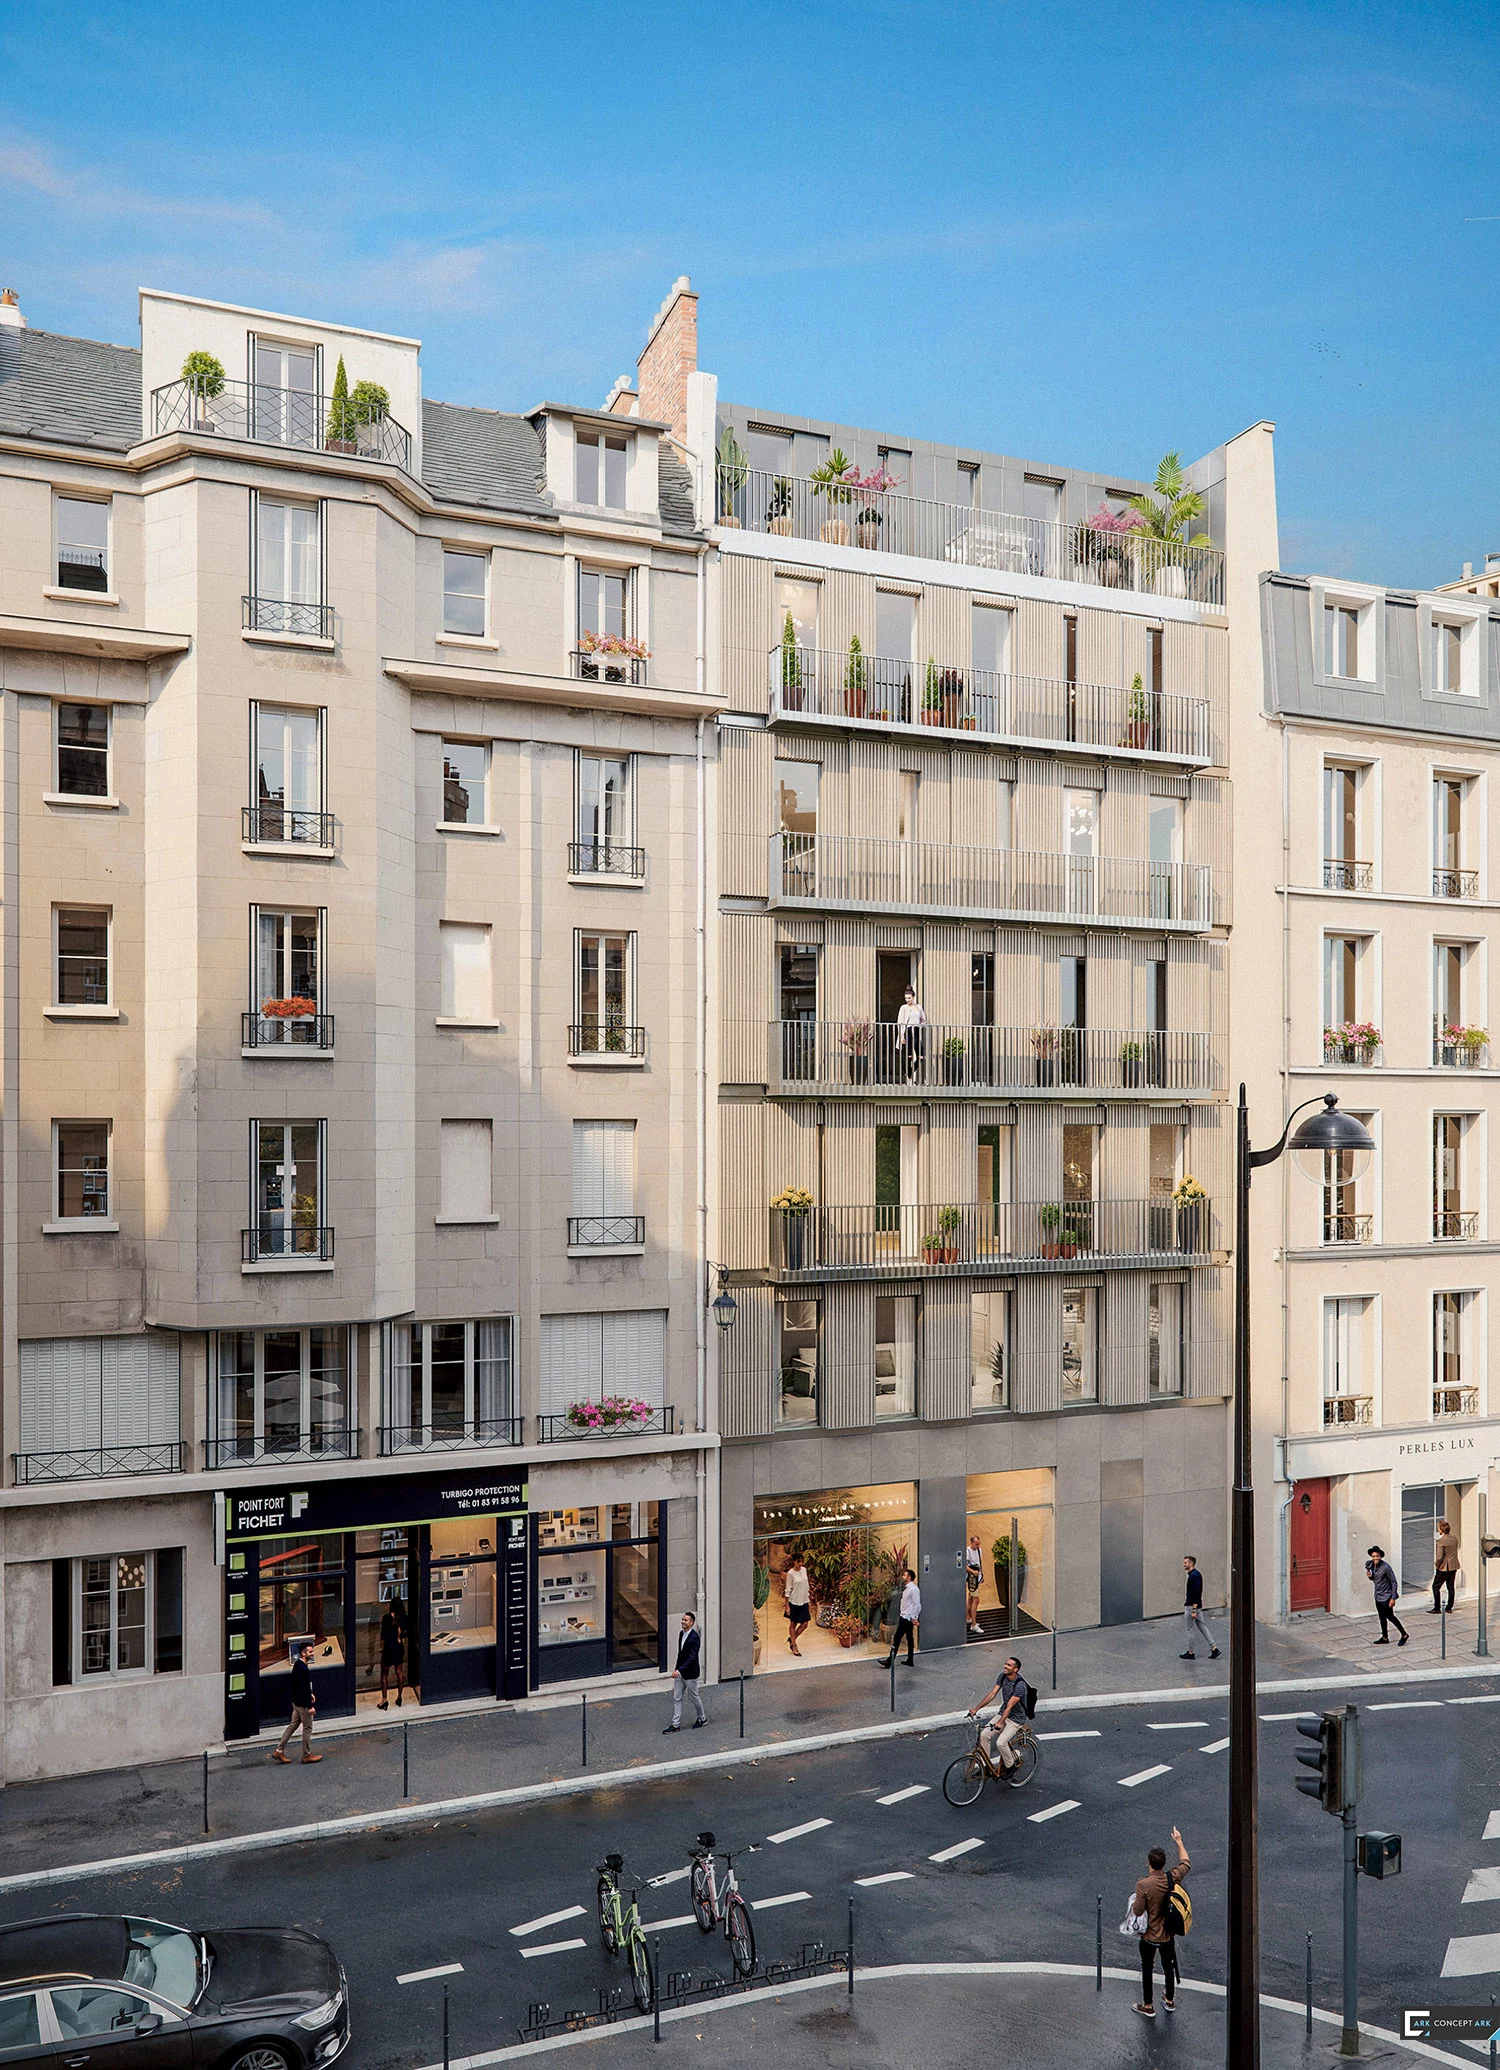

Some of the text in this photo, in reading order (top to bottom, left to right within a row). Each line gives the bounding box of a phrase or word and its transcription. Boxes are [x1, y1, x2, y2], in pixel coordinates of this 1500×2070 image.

[1399, 1438, 1474, 1455] PERLES LUX
[441, 1485, 520, 1499] TURBIGO PROTECTION
[238, 1497, 285, 1512] POINT FORT
[458, 1500, 471, 1509] Tél:
[481, 1499, 490, 1507] 83
[492, 1498, 499, 1506] 91
[501, 1497, 510, 1505] 58
[511, 1496, 520, 1504] 96
[238, 1513, 285, 1530] FICHET
